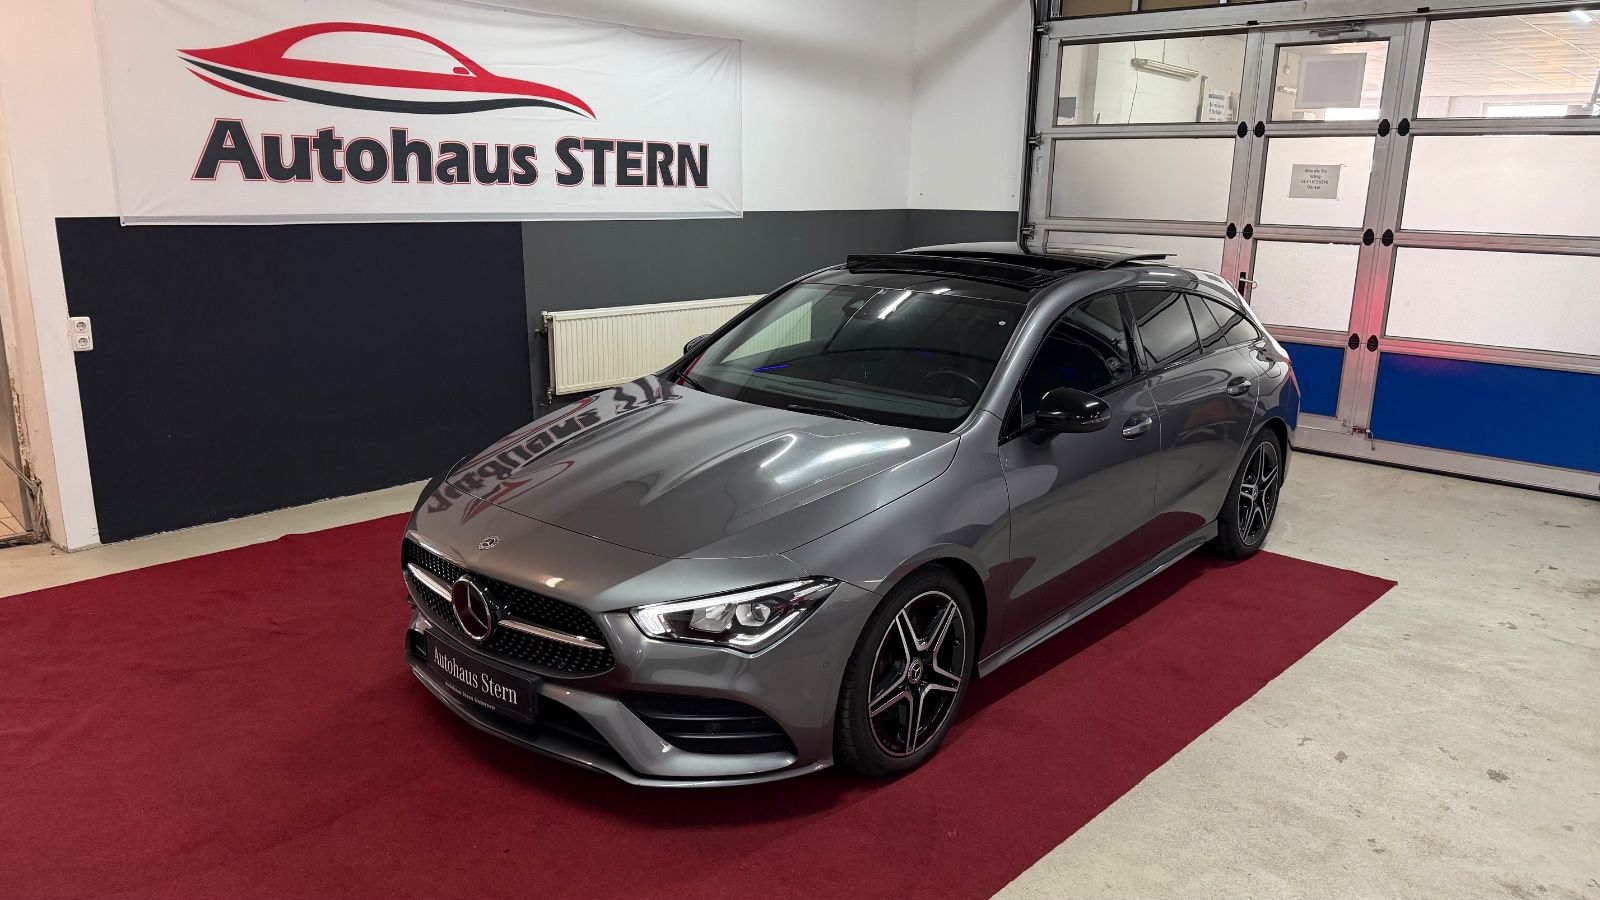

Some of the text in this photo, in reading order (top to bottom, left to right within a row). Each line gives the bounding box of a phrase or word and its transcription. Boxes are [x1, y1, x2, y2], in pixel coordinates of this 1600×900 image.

[191, 118, 709, 188] Autohaus STERN
[433, 645, 518, 705] Autohaus Stern
